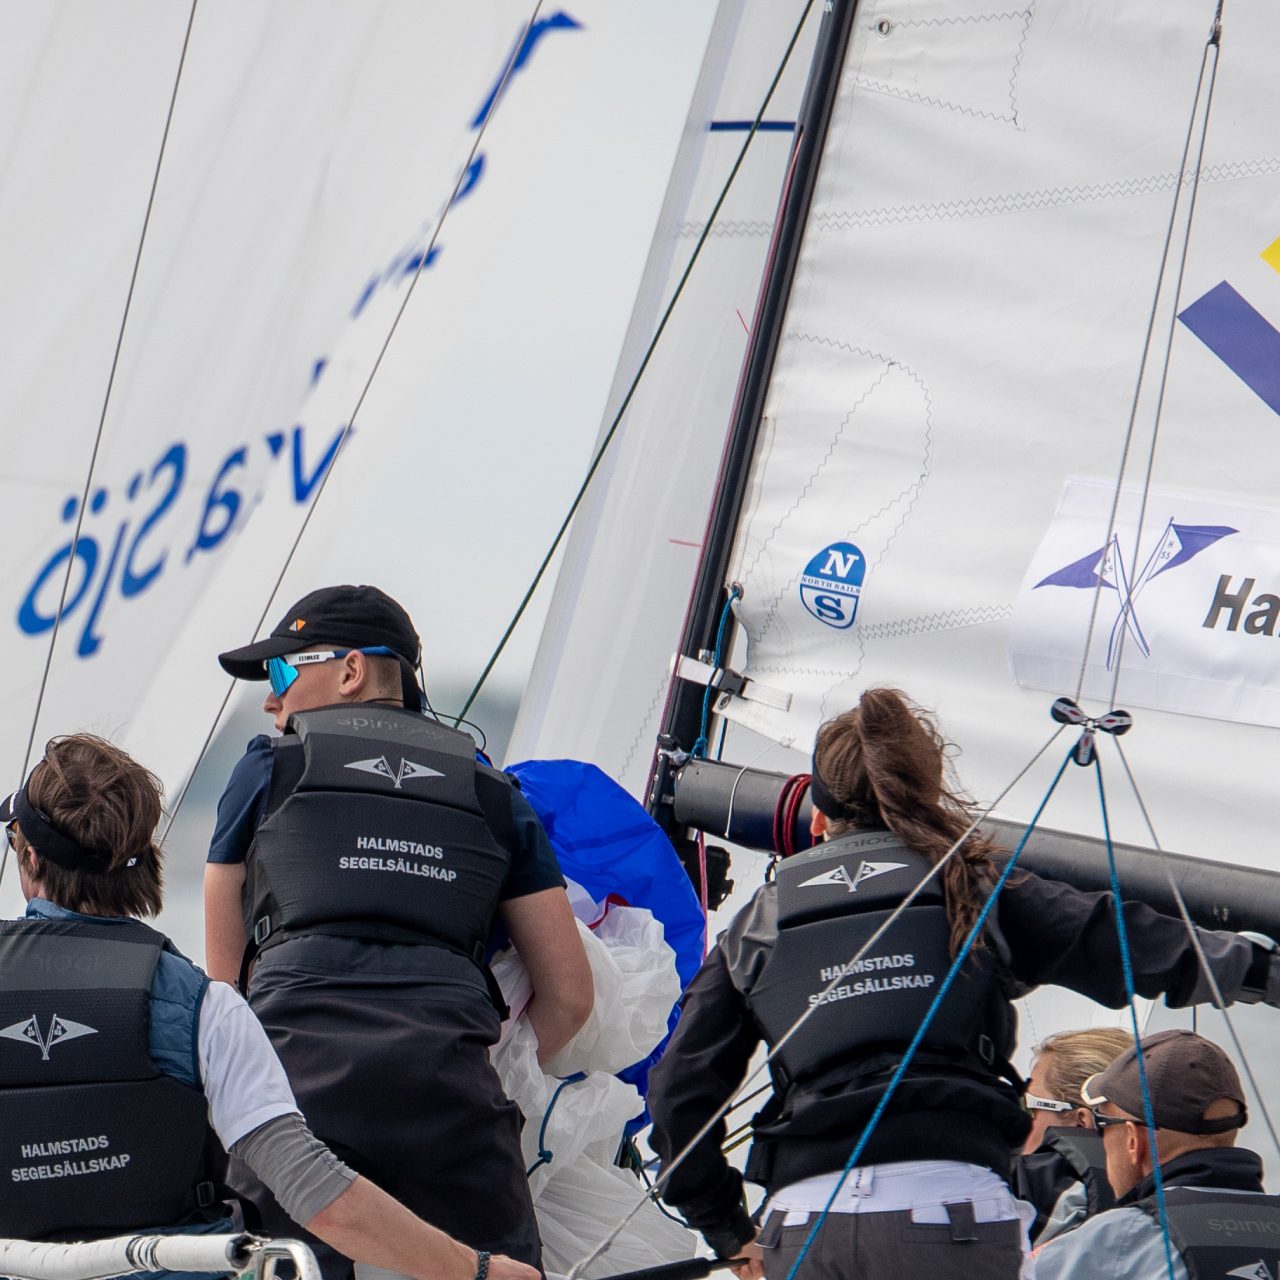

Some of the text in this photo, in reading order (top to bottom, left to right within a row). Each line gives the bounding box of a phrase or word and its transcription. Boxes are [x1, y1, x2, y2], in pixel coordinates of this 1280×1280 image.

[819, 549, 860, 578] N
[801, 576, 861, 594] NORTH SAILS
[814, 595, 846, 621] S
[1202, 574, 1280, 638] Ha
[357, 837, 443, 859] HALMSTADS
[339, 857, 457, 881] SEGELSÄLLSKAP
[820, 954, 915, 981] HALMSTADS
[808, 975, 935, 1008] SEGELSÄLLSKAP
[21, 1136, 109, 1158] HALMSTADS
[11, 1154, 131, 1181] SEGELSÄLLSKAP
